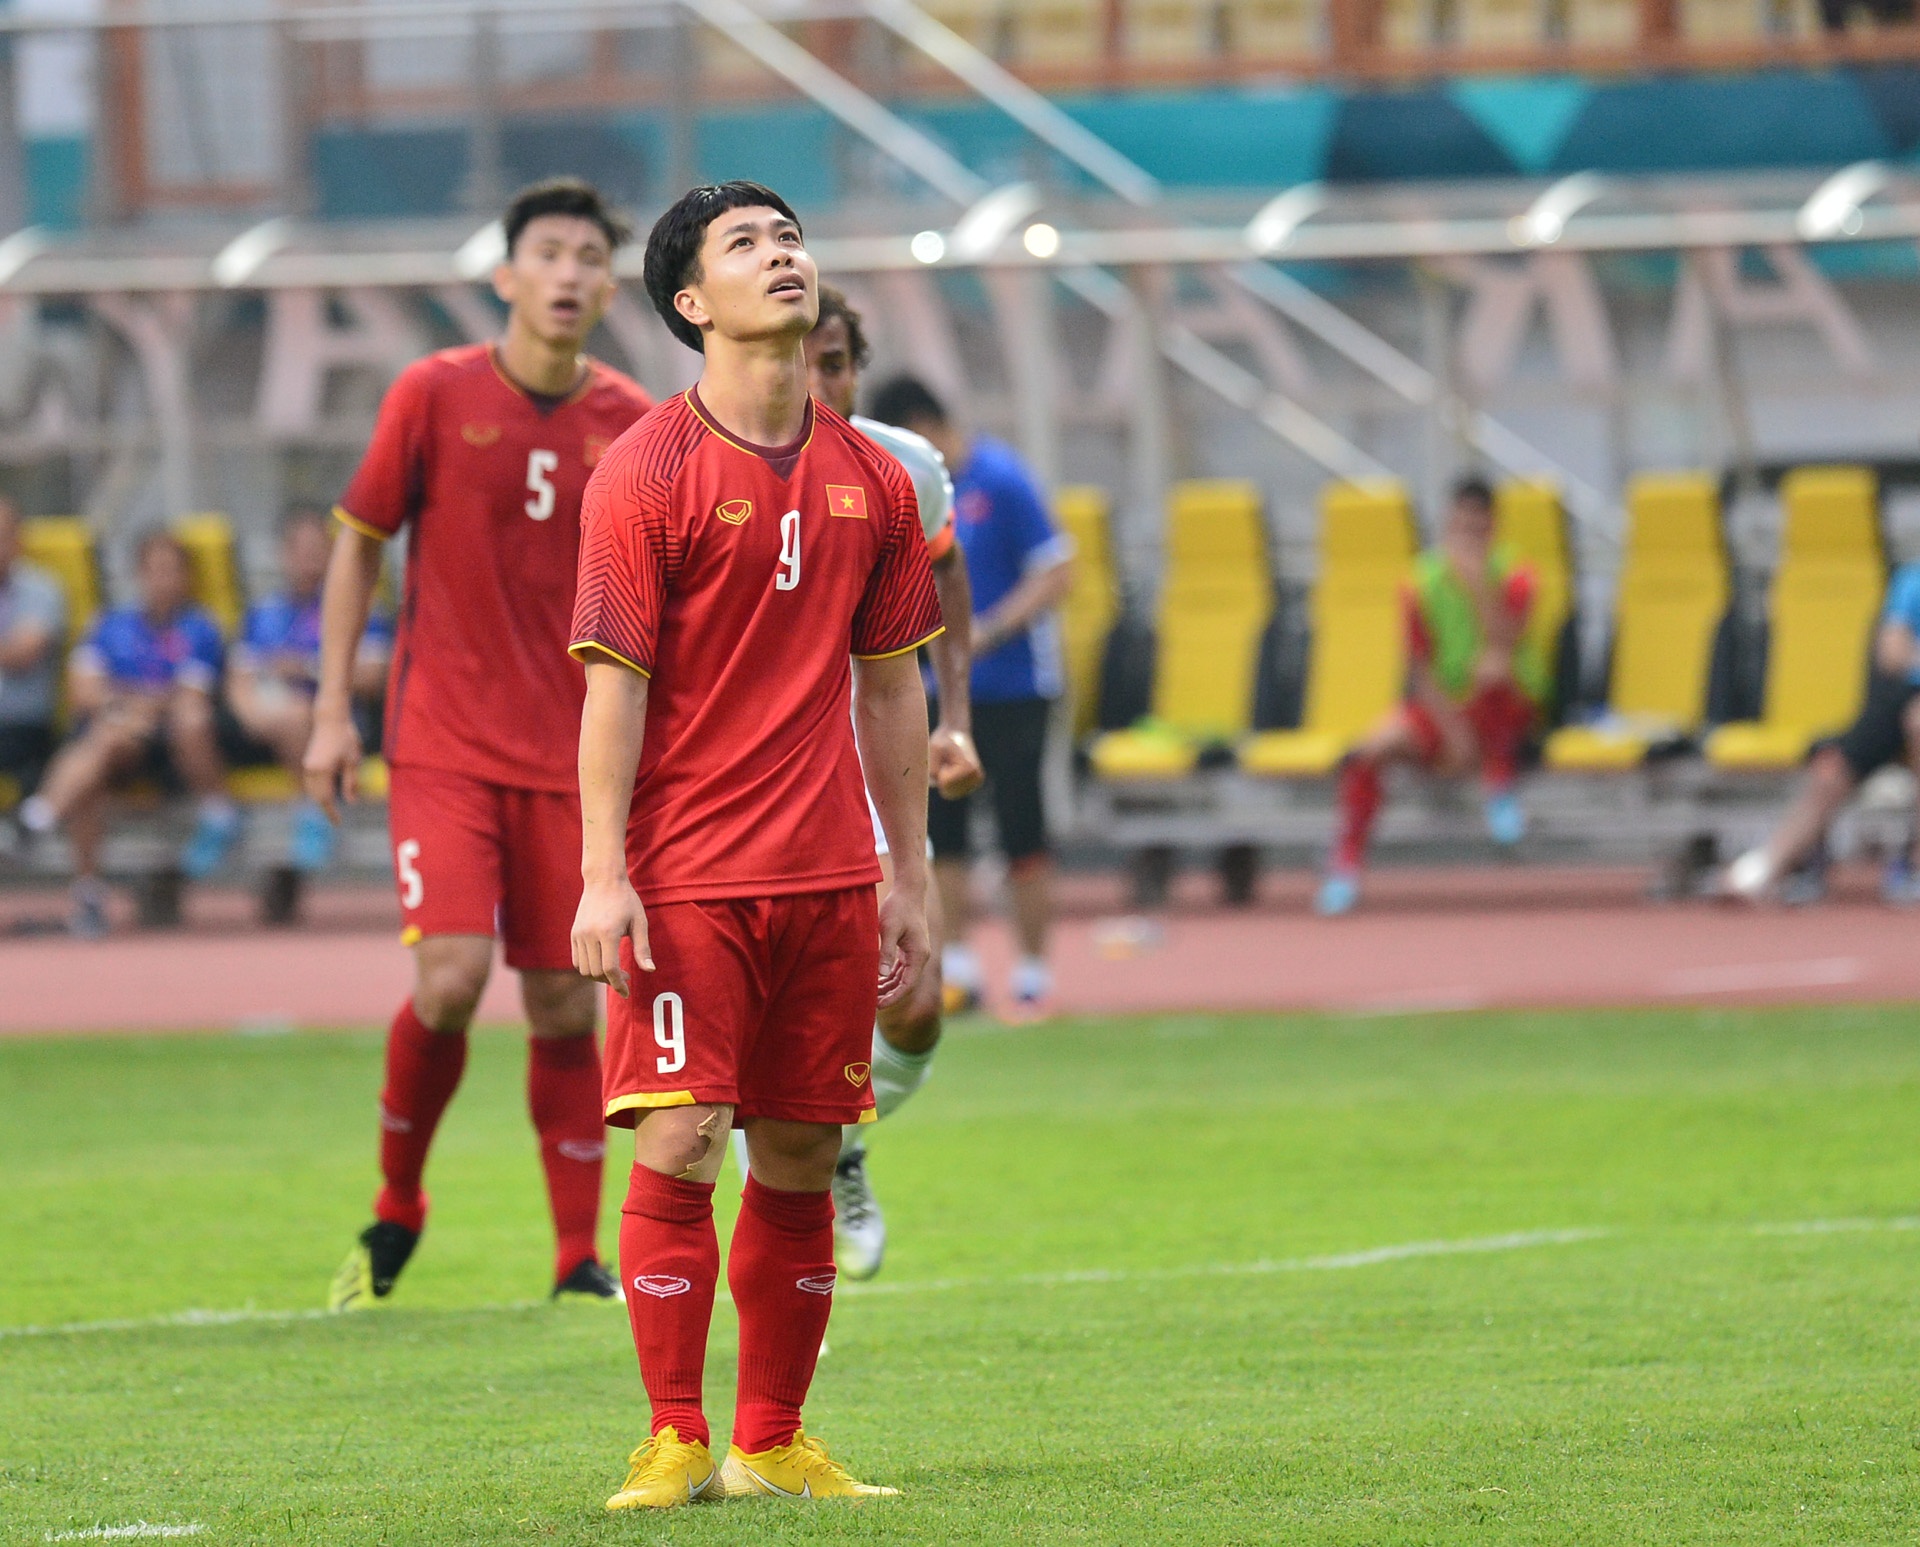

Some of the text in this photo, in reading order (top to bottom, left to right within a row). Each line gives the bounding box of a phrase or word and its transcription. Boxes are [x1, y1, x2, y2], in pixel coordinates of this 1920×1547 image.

[525, 449, 558, 522] 5
[775, 509, 801, 591] 9
[396, 839, 424, 910] 5
[652, 991, 687, 1074] 9
